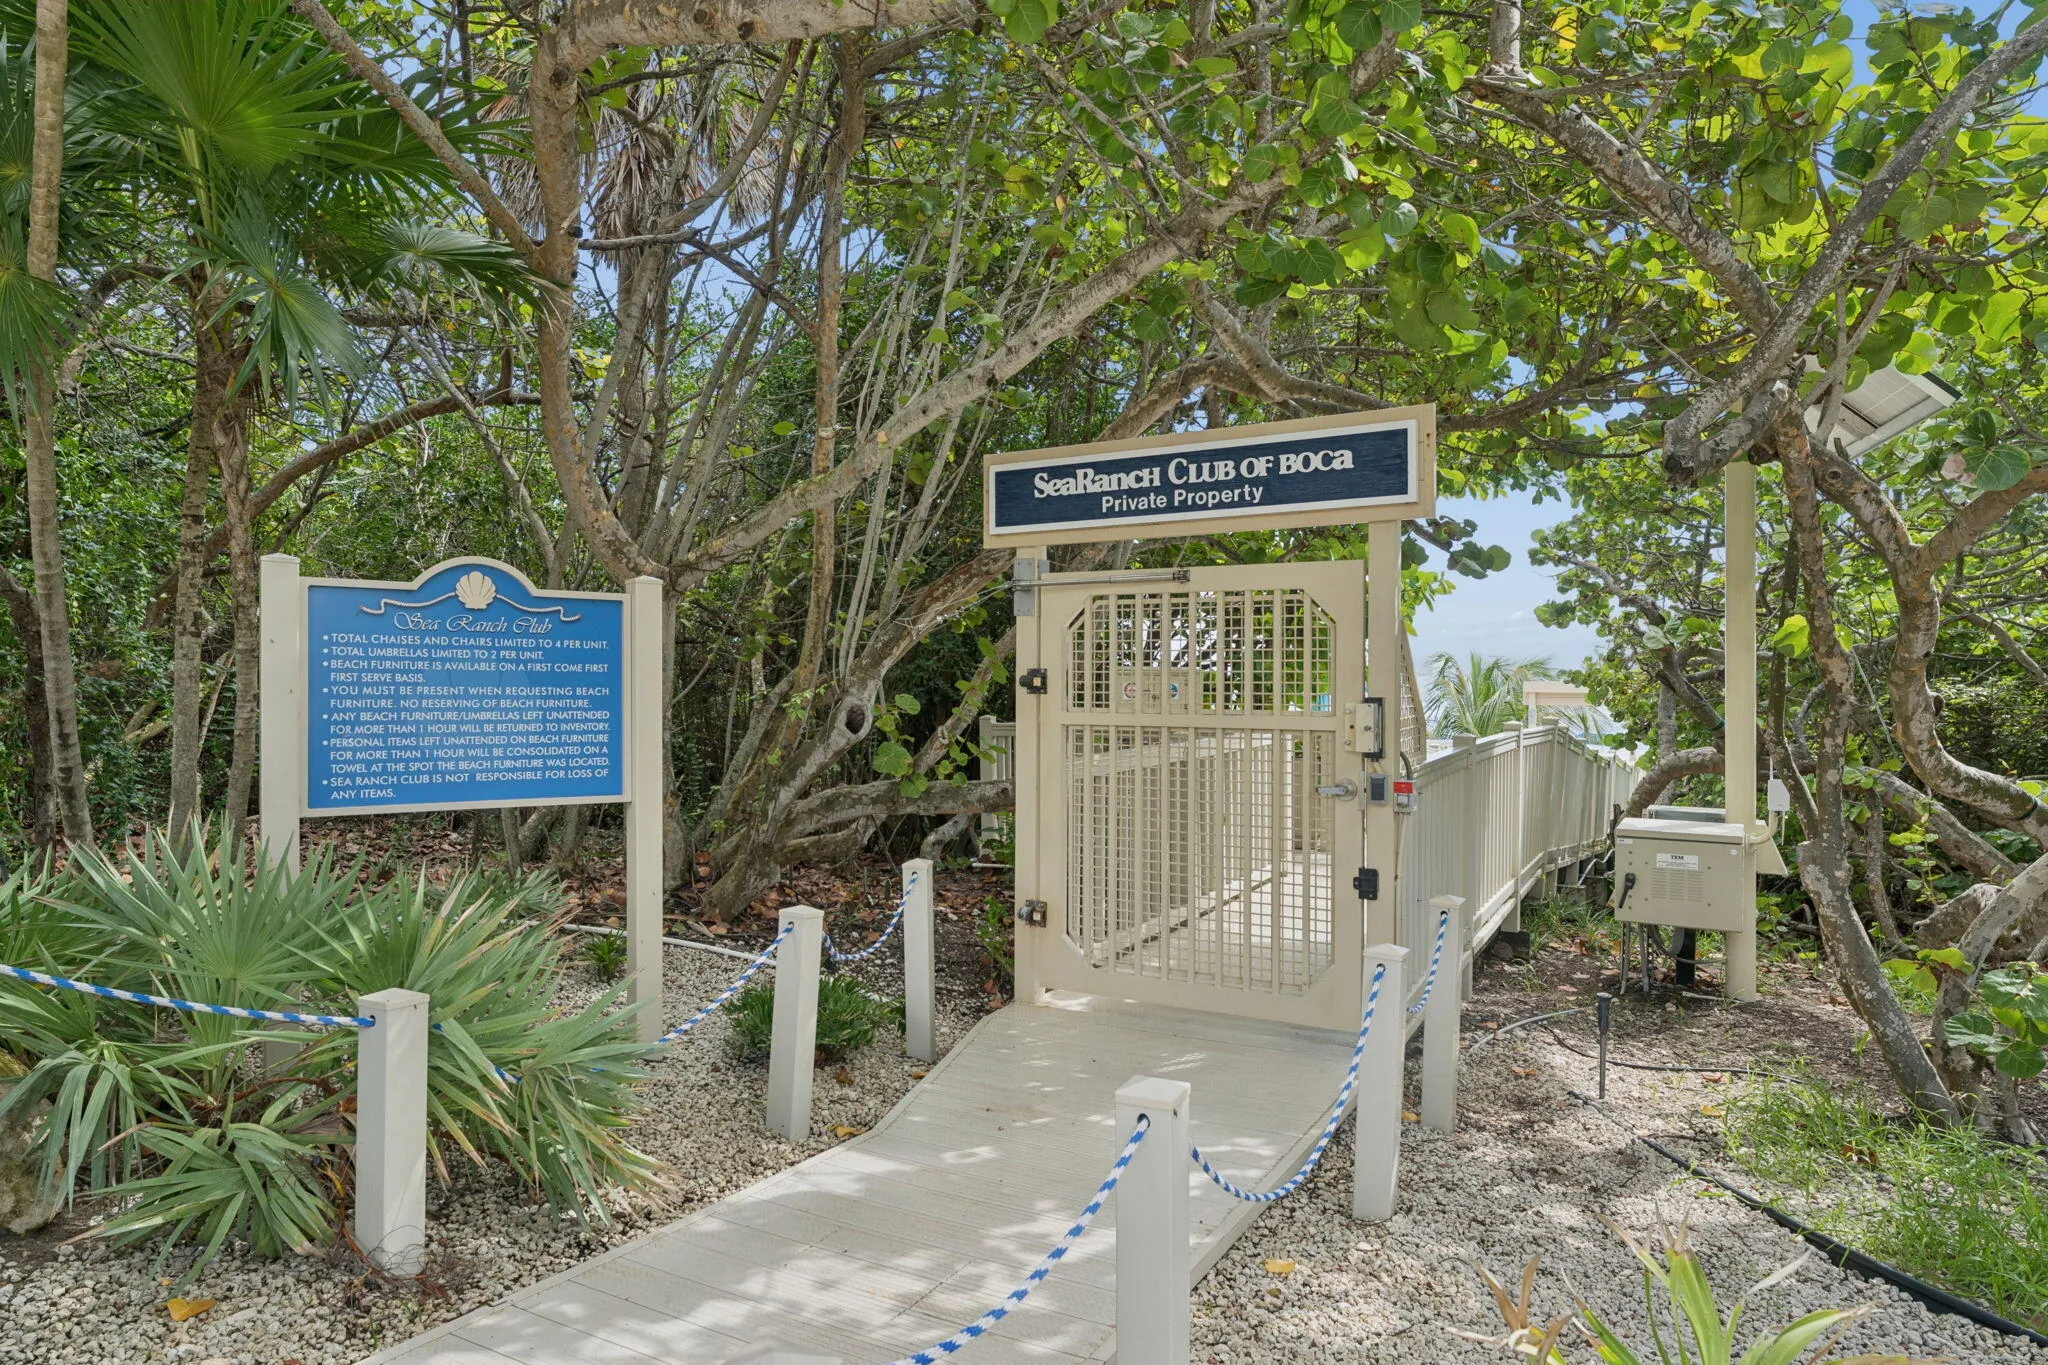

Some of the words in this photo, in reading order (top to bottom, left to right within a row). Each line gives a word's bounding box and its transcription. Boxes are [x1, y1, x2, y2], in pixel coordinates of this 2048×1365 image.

[1240, 455, 1273, 478] OF
[1101, 494, 1167, 513] Private
[1174, 484, 1264, 508] Property
[394, 612, 440, 630] Sea
[446, 615, 508, 633] Ranch
[513, 616, 553, 634] Club
[331, 634, 368, 643] TOTAL
[371, 635, 421, 645] CHAISES
[423, 636, 449, 646] AND
[452, 637, 492, 647] CHAIRS
[494, 638, 536, 648] LIMITED
[539, 640, 553, 648] TO
[555, 640, 561, 648] 4
[564, 640, 581, 649] PER
[583, 641, 609, 649] UNIT.
[331, 647, 365, 656] TOTAL
[368, 648, 429, 658] UMBRELLAS
[432, 650, 471, 658] LIMITED
[474, 650, 488, 658] TO
[491, 650, 497, 658] 2
[500, 651, 517, 659] PER
[520, 651, 544, 660] UNIT.
[331, 660, 368, 669] BEACH
[371, 660, 430, 670] FURNITURE
[432, 662, 442, 670] IS
[444, 662, 497, 671] AVAILABLE
[499, 663, 516, 671] ON
[518, 663, 526, 671] A
[528, 664, 551, 672] FIRST
[554, 664, 583, 672] COME
[585, 664, 609, 672] FIRST
[330, 673, 359, 682] FIRST
[361, 673, 392, 682] SERVE
[396, 674, 426, 682] BASIS.
[332, 686, 358, 695] YOU
[362, 686, 396, 695] MUST
[400, 686, 413, 695] BE
[417, 687, 465, 695] PRESENT
[468, 687, 501, 695] WHEN
[506, 688, 573, 696] REQUESTING
[576, 688, 609, 696] BEACH
[330, 700, 397, 708] FURNITURE.
[400, 700, 419, 708] NO
[422, 700, 480, 708] RESERVING
[483, 700, 499, 708] OF
[500, 700, 534, 708] BEACH
[536, 700, 592, 708] FURNITURE.
[331, 712, 357, 721] ANY
[360, 712, 397, 721] BEACH
[401, 712, 520, 720] FURNITURE/UMBRELLAS
[522, 712, 544, 720] LEFT
[547, 711, 610, 720] UNATTENDED
[330, 725, 352, 734] FOR
[354, 725, 385, 734] MORE
[387, 724, 416, 733] THAN
[420, 725, 424, 733] 1
[428, 724, 457, 733] HOUR
[460, 724, 481, 732] WILL
[484, 724, 494, 732] BE
[497, 724, 543, 732] RETURNED
[546, 723, 558, 732] TO
[561, 723, 610, 731] INVENTORY.
[330, 738, 385, 747] PERSONAL
[388, 738, 417, 746] ITEMS
[420, 737, 441, 746] LEFT
[444, 736, 508, 745] UNATTENDED
[510, 735, 526, 744] ON
[529, 735, 559, 744] BEACH
[562, 734, 609, 743] FURNITURE
[330, 751, 353, 761] FOR
[356, 750, 388, 760] MORE
[391, 750, 421, 759] THAN
[425, 750, 429, 758] 1
[434, 749, 465, 758] HOUR
[468, 748, 490, 757] WILL
[492, 748, 504, 757] BE
[507, 746, 581, 756] CONSOLIDATED
[583, 746, 599, 755] ON
[601, 746, 609, 754] A
[331, 764, 368, 774] TOWEL
[370, 763, 383, 773] AT
[386, 763, 406, 772] THE
[408, 762, 434, 772] SPOT
[437, 762, 456, 771] THE
[458, 760, 491, 770] BEACH
[494, 759, 544, 769] FURNITURE
[546, 758, 566, 767] WAS
[330, 777, 353, 787] SEA
[356, 776, 397, 786] RANCH
[400, 775, 430, 785] CLUB
[432, 775, 442, 783] IS
[446, 774, 470, 783] NOT
[476, 771, 543, 782] RESPONSIBLE
[546, 770, 566, 779] FOR
[568, 770, 592, 778] LOSS
[594, 769, 609, 777] OF
[331, 790, 357, 800] ANY
[361, 789, 396, 798] ITEMS.
